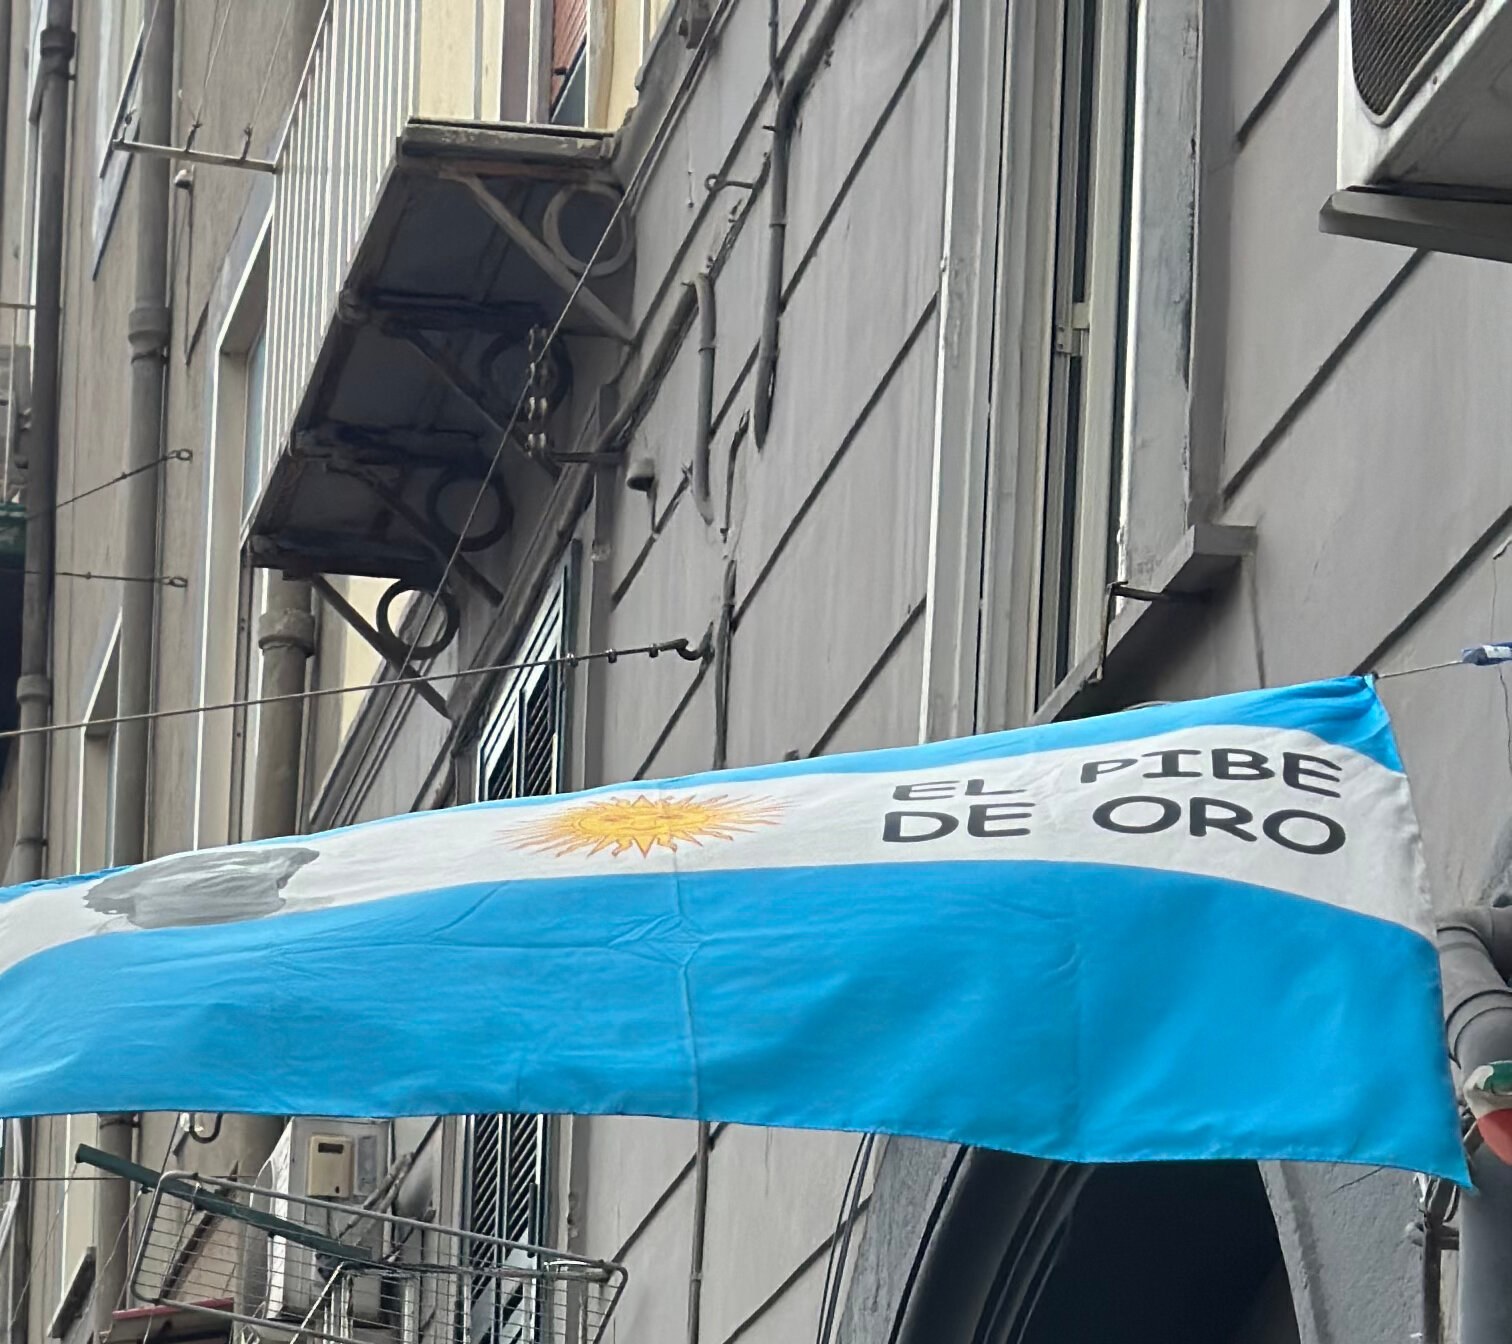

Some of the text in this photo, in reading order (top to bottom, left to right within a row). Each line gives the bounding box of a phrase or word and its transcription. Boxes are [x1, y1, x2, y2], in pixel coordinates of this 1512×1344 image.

[892, 748, 1343, 802] EL PIBE
[882, 794, 1347, 856] DE ORO
